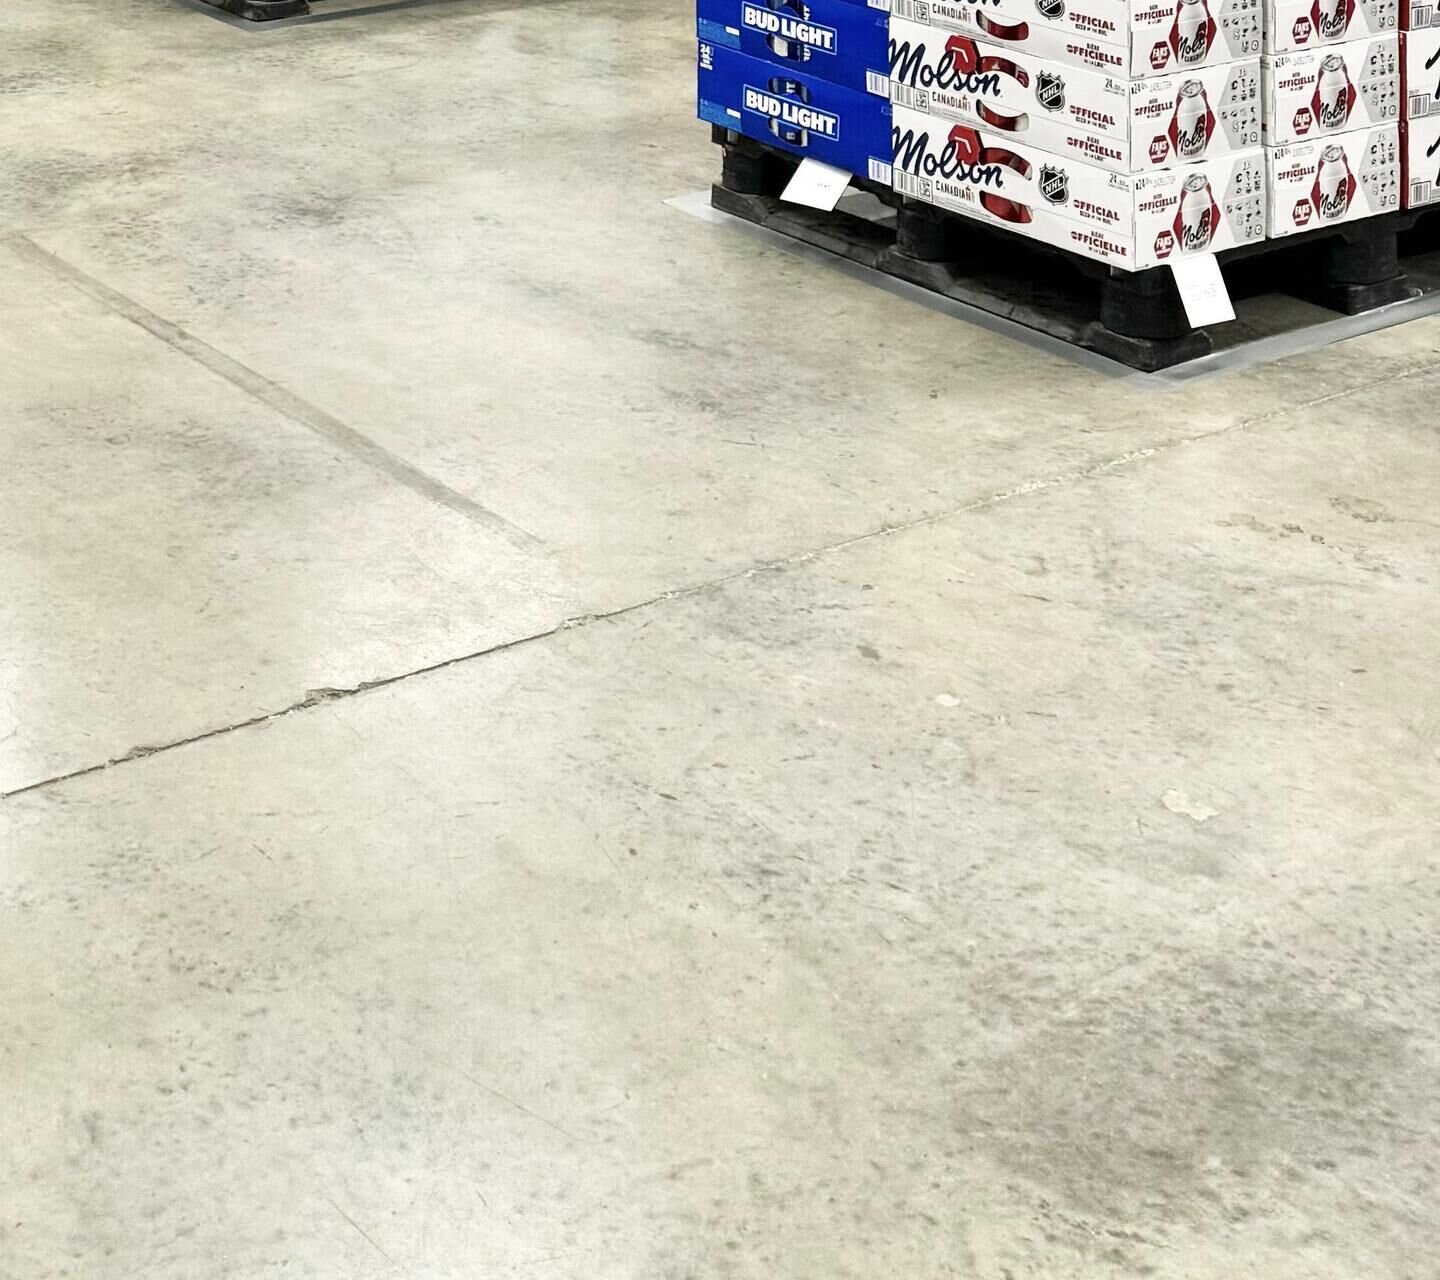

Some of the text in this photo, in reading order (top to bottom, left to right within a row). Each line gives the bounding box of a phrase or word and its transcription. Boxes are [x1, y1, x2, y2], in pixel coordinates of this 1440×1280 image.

[745, 7, 834, 49] BUD LIGHT
[746, 90, 836, 135] BUD LIGHT
